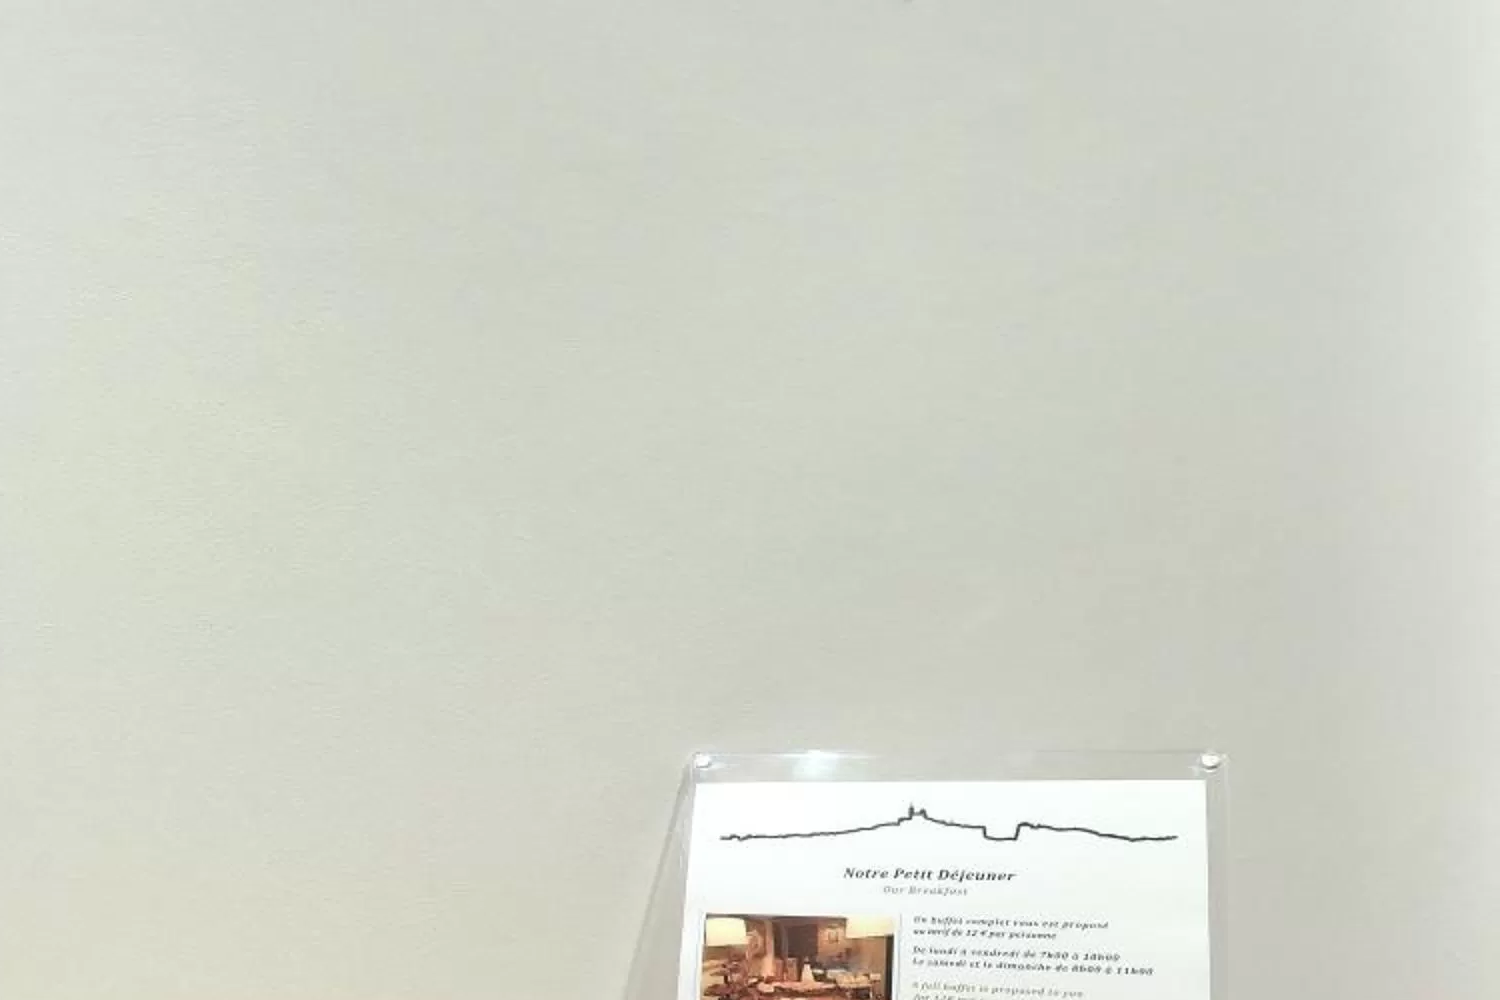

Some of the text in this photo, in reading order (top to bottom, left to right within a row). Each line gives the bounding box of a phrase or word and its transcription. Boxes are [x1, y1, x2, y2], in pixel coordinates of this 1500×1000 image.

[842, 867, 1018, 884] Notre Petit Déjeuner
[883, 885, 969, 898] Our Breakfast
